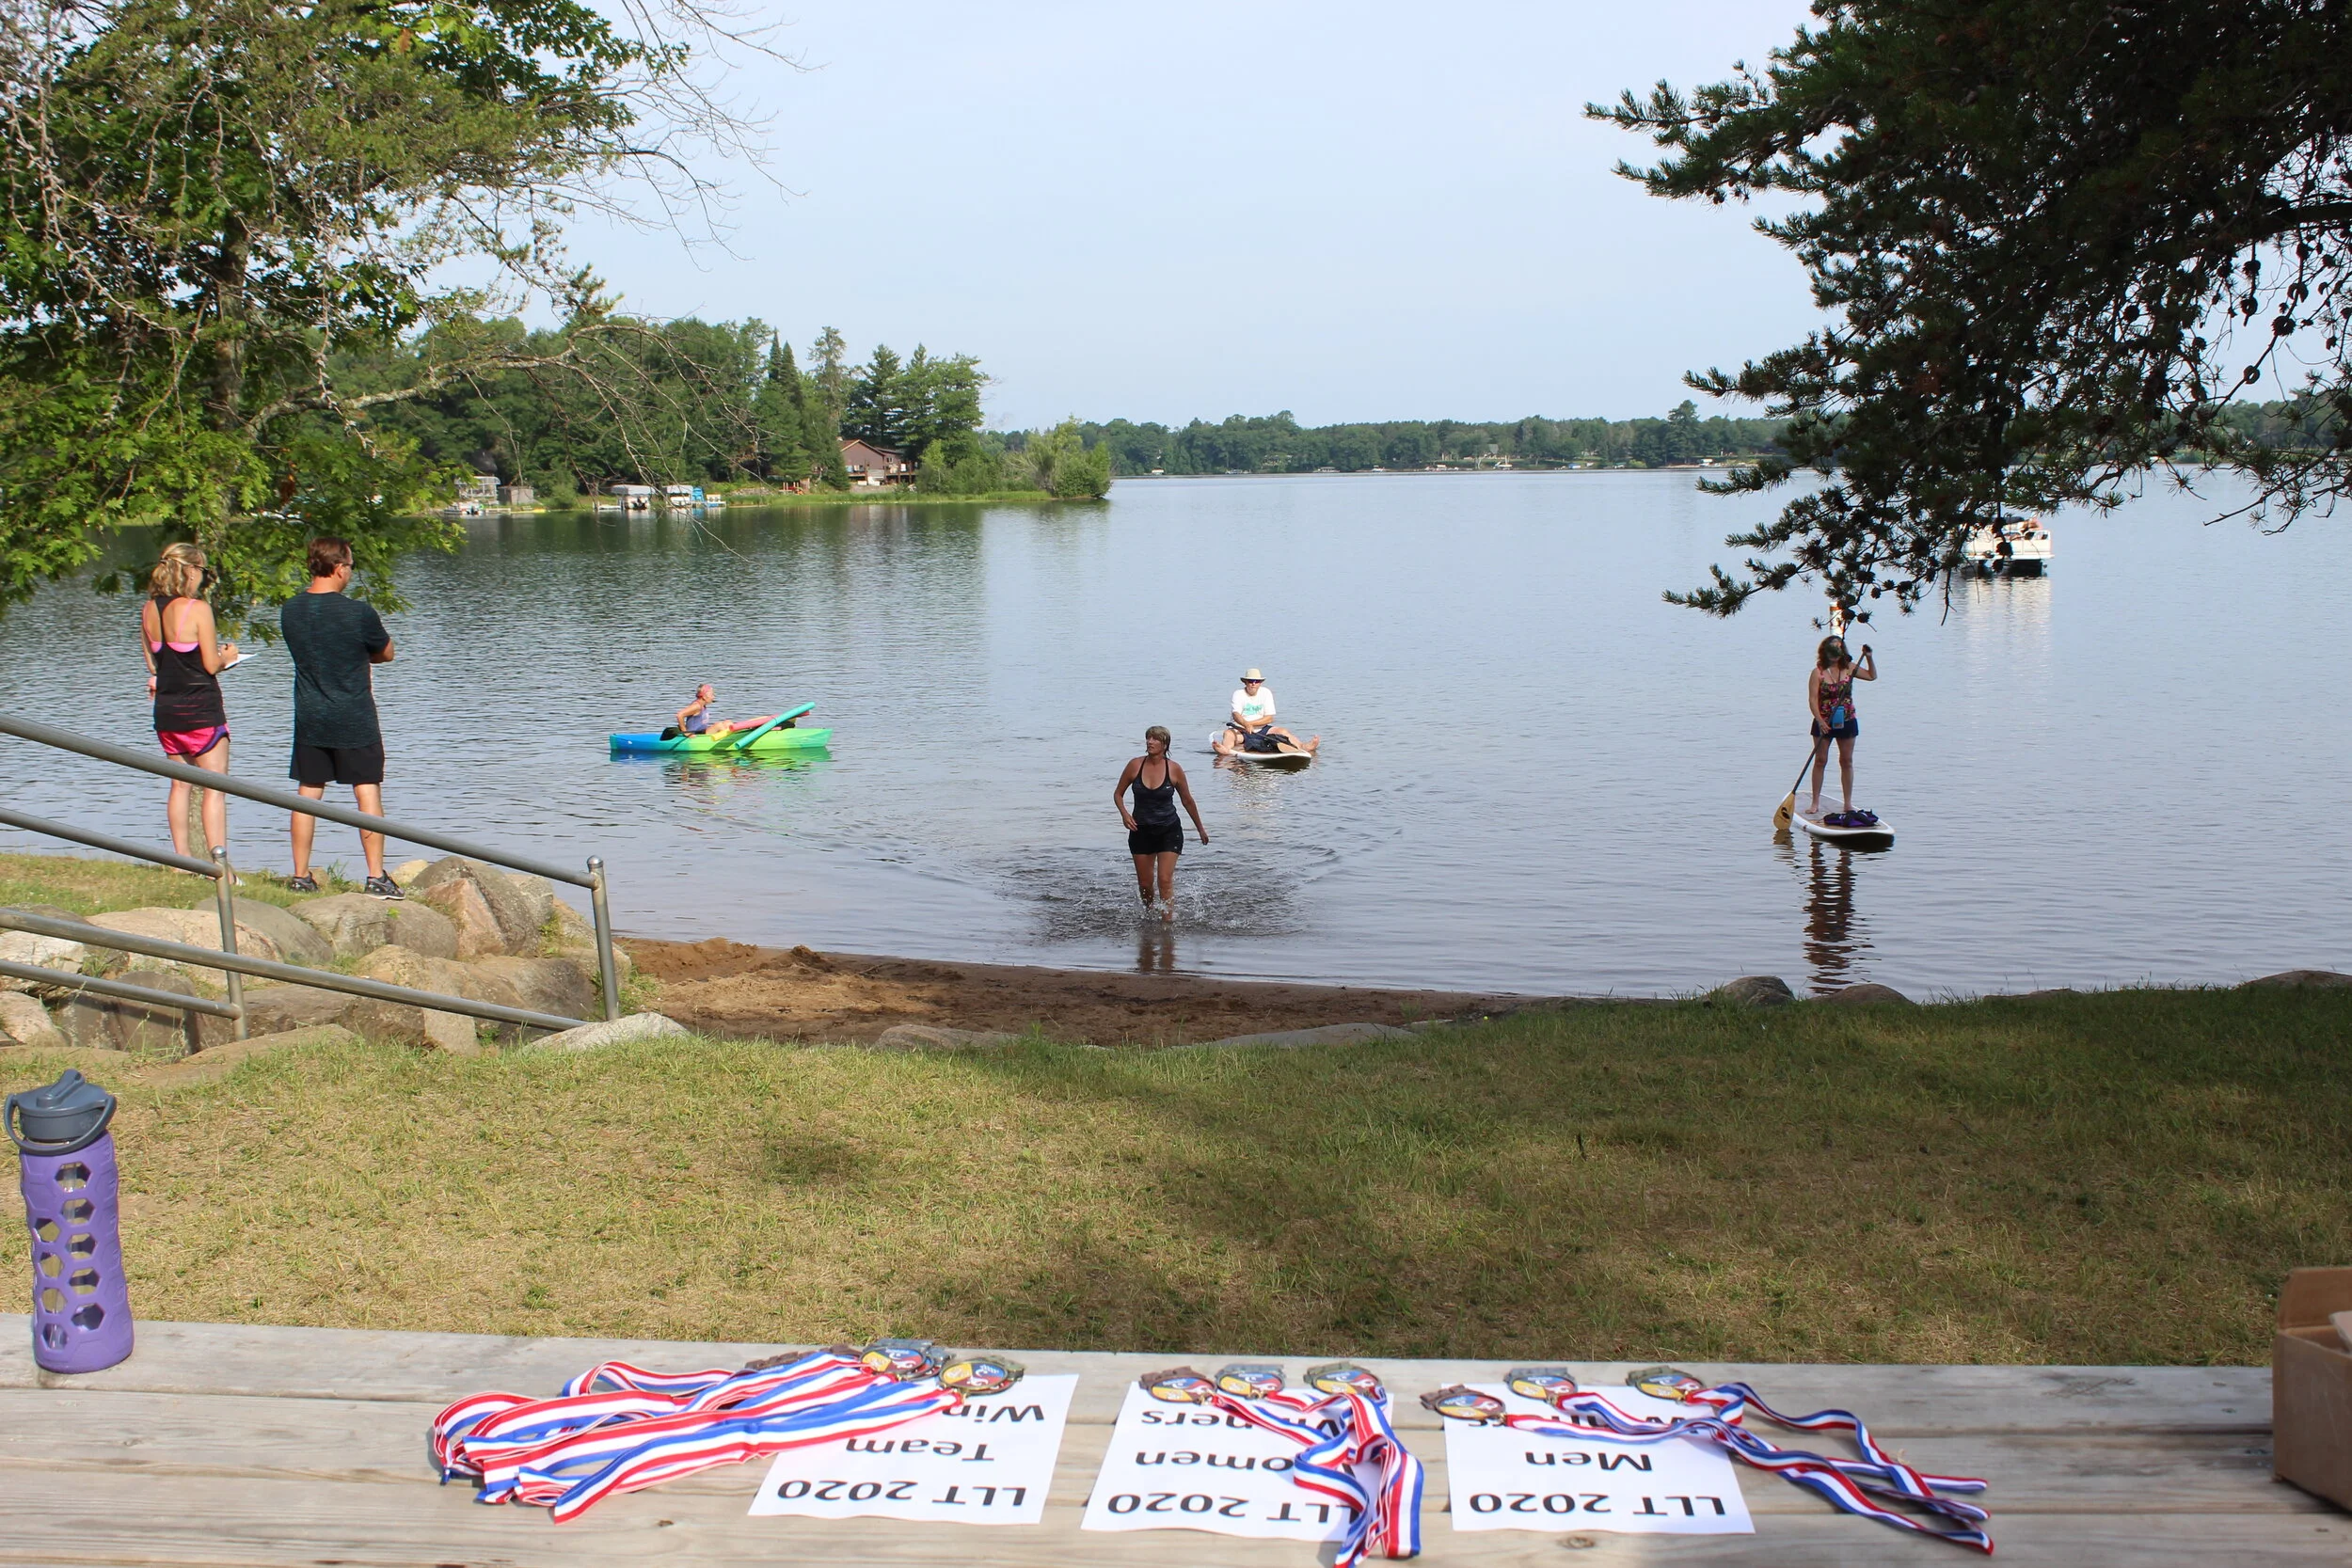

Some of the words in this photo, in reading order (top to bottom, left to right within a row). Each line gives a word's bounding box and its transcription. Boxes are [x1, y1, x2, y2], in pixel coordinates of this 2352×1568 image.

[845, 1437, 995, 1463] Team
[1135, 1450, 1356, 1478] omen
[1524, 1451, 1653, 1473] Men
[776, 1480, 918, 1502] 2020
[931, 1485, 1027, 1508] LLT
[1107, 1493, 1249, 1518] 2020
[1469, 1493, 1613, 1514] 2020
[1632, 1495, 1726, 1517] LLT
